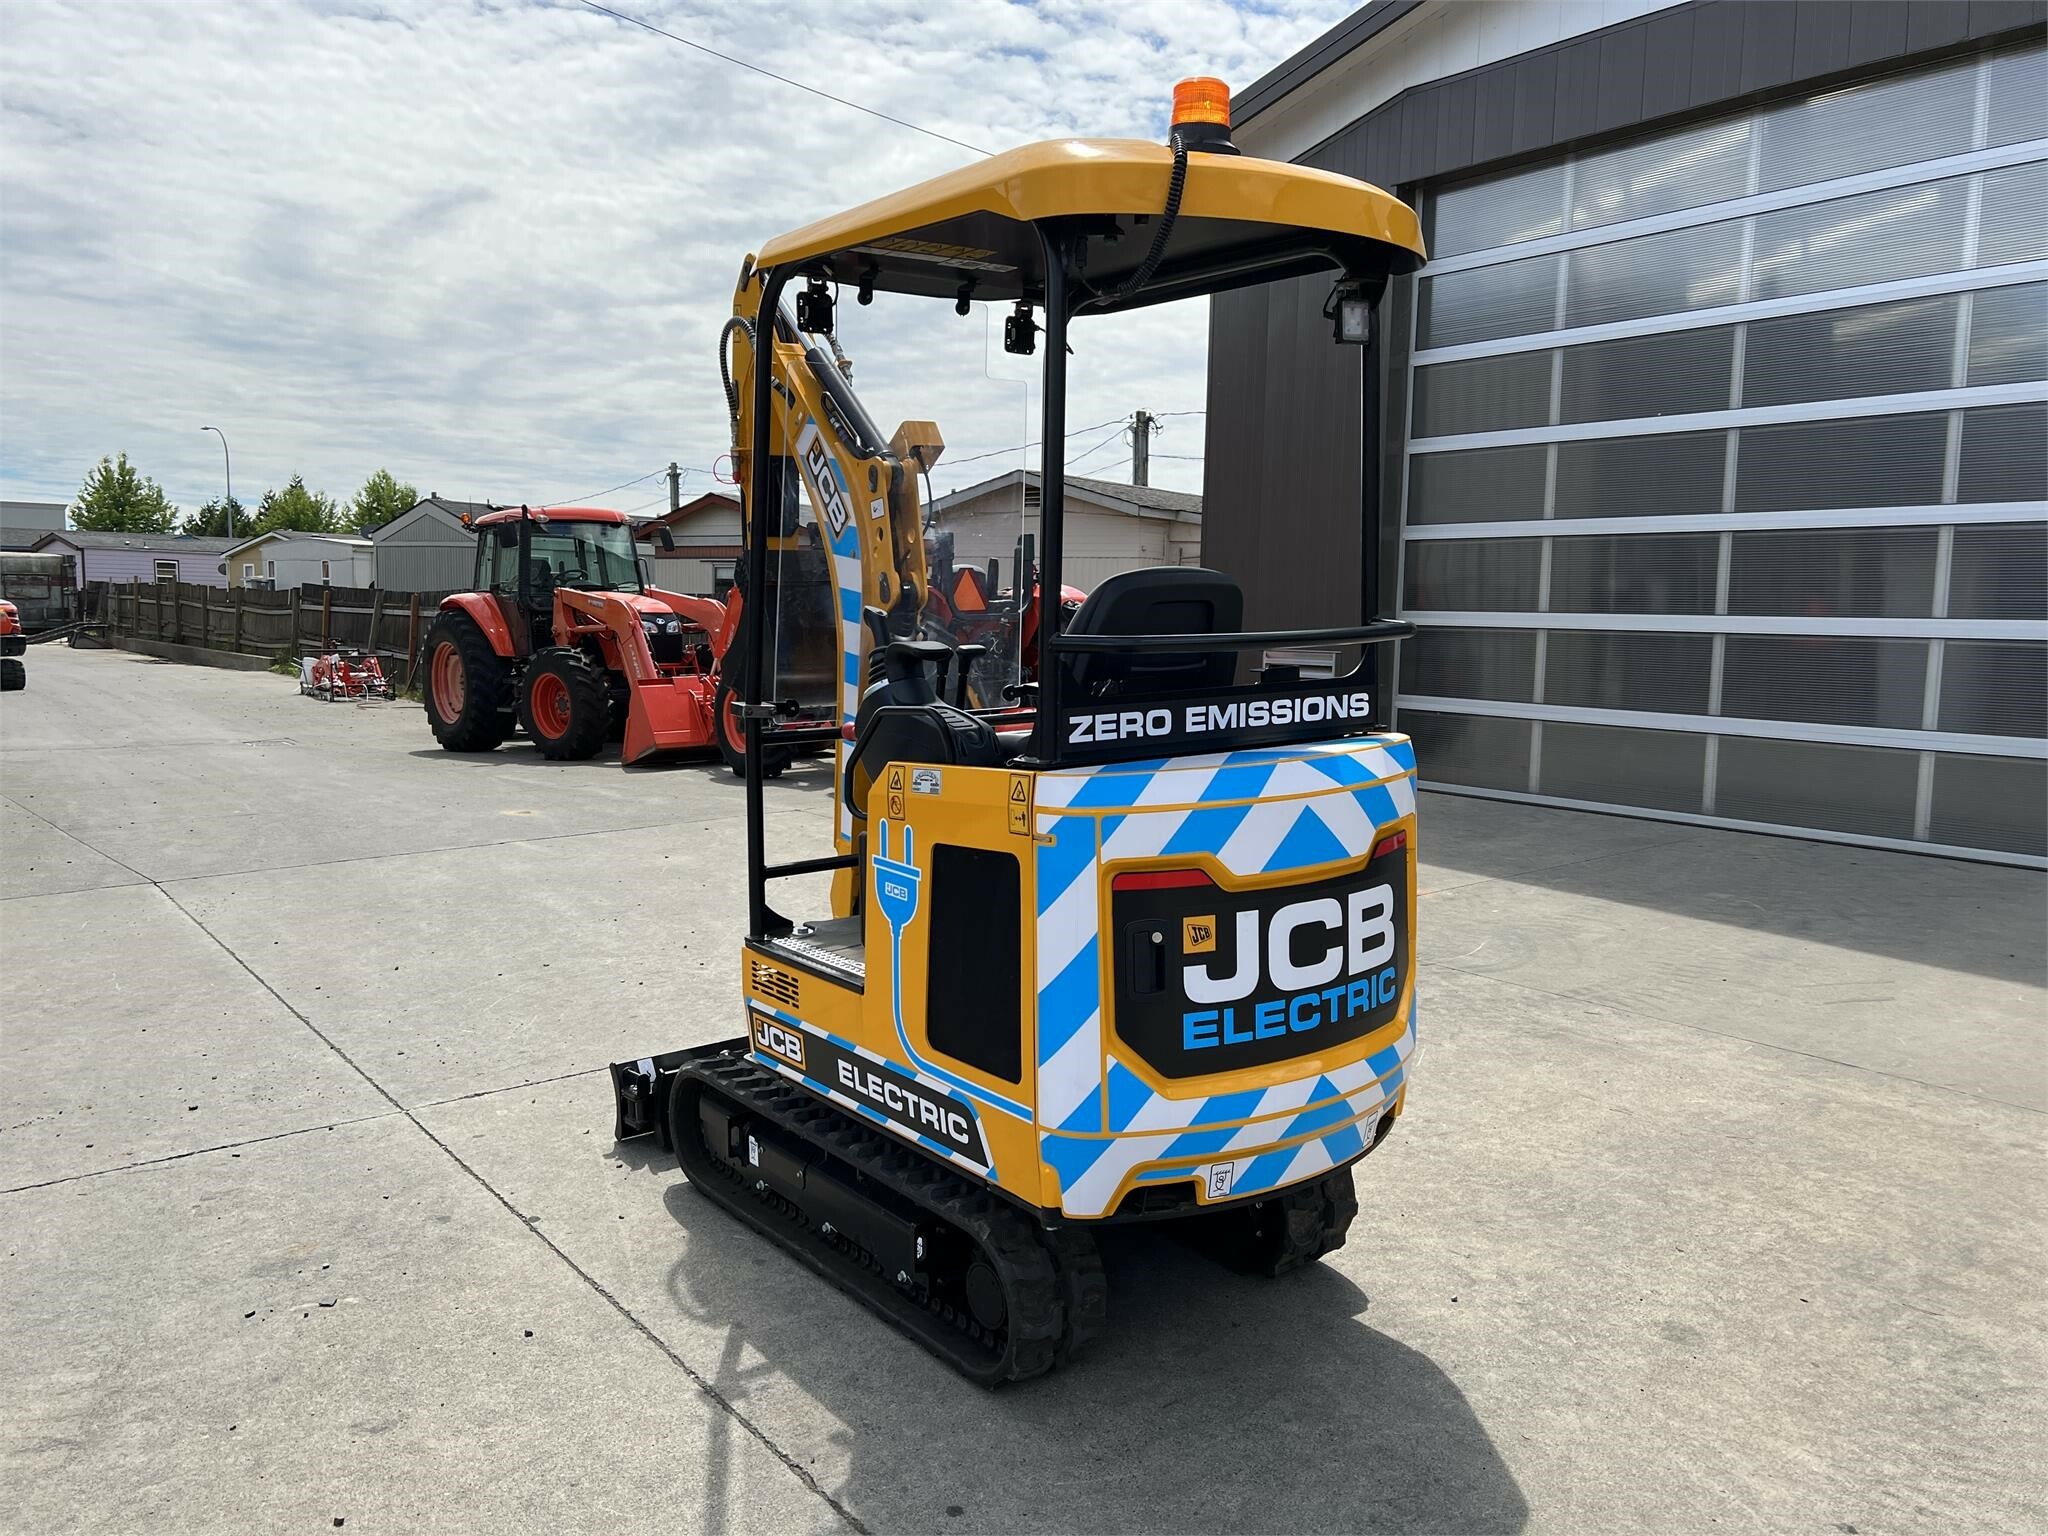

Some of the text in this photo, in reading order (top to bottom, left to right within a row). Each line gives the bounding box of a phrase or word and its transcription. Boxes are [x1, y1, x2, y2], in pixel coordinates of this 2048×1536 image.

[809, 451, 848, 533] JCB
[1069, 692, 1370, 744] ZERO EMISSIONS
[886, 883, 906, 899] JCB
[1183, 883, 1396, 1004] JCB
[1191, 926, 1211, 944] JCB
[1183, 966, 1397, 1050] ELECTRIC
[757, 1022, 802, 1062] JCB
[837, 1058, 969, 1145] ELECTRIC
